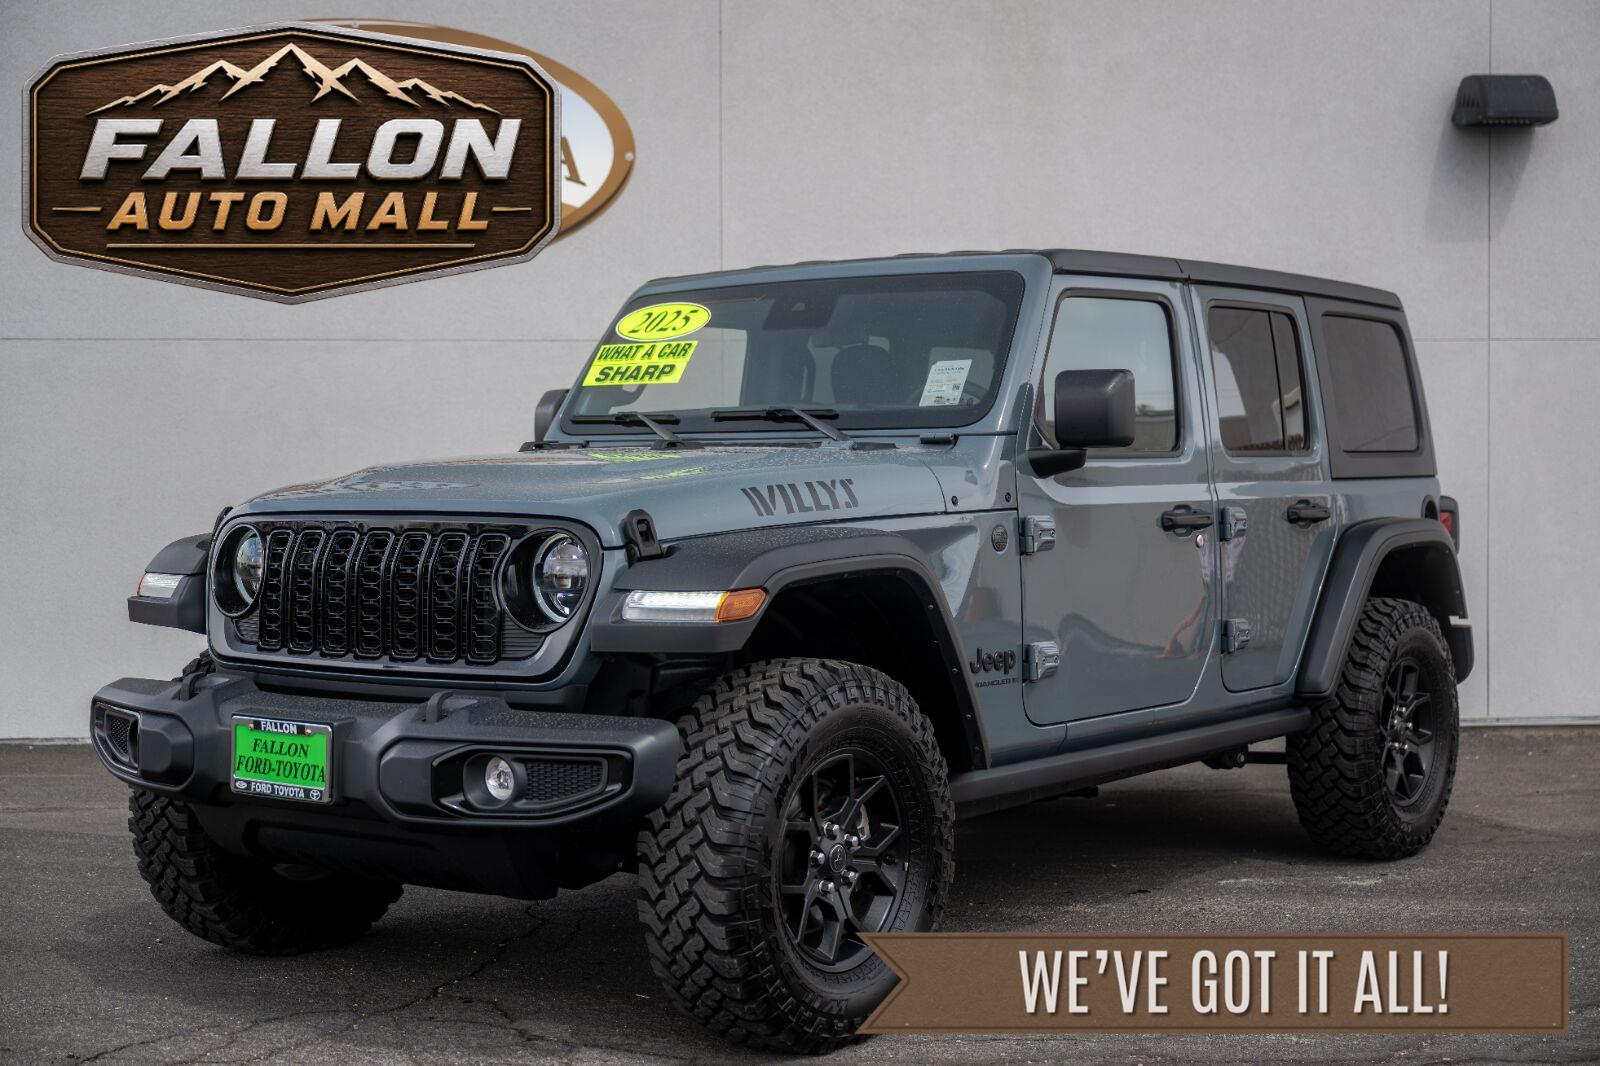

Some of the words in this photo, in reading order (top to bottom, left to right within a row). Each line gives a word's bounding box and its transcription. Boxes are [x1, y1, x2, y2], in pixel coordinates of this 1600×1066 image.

[628, 309, 700, 334] 2025
[597, 344, 643, 361] WHAT
[640, 344, 657, 360] A
[657, 342, 693, 359] CAR
[594, 364, 676, 383] SHARP
[740, 479, 859, 517] WILLYS
[969, 647, 1016, 675] Jeep
[260, 721, 297, 735] FALLON
[252, 738, 310, 758] FALLON
[236, 755, 326, 783] FORD-TOYOTA
[250, 782, 272, 793] FORD
[273, 785, 305, 798] TOYOTA
